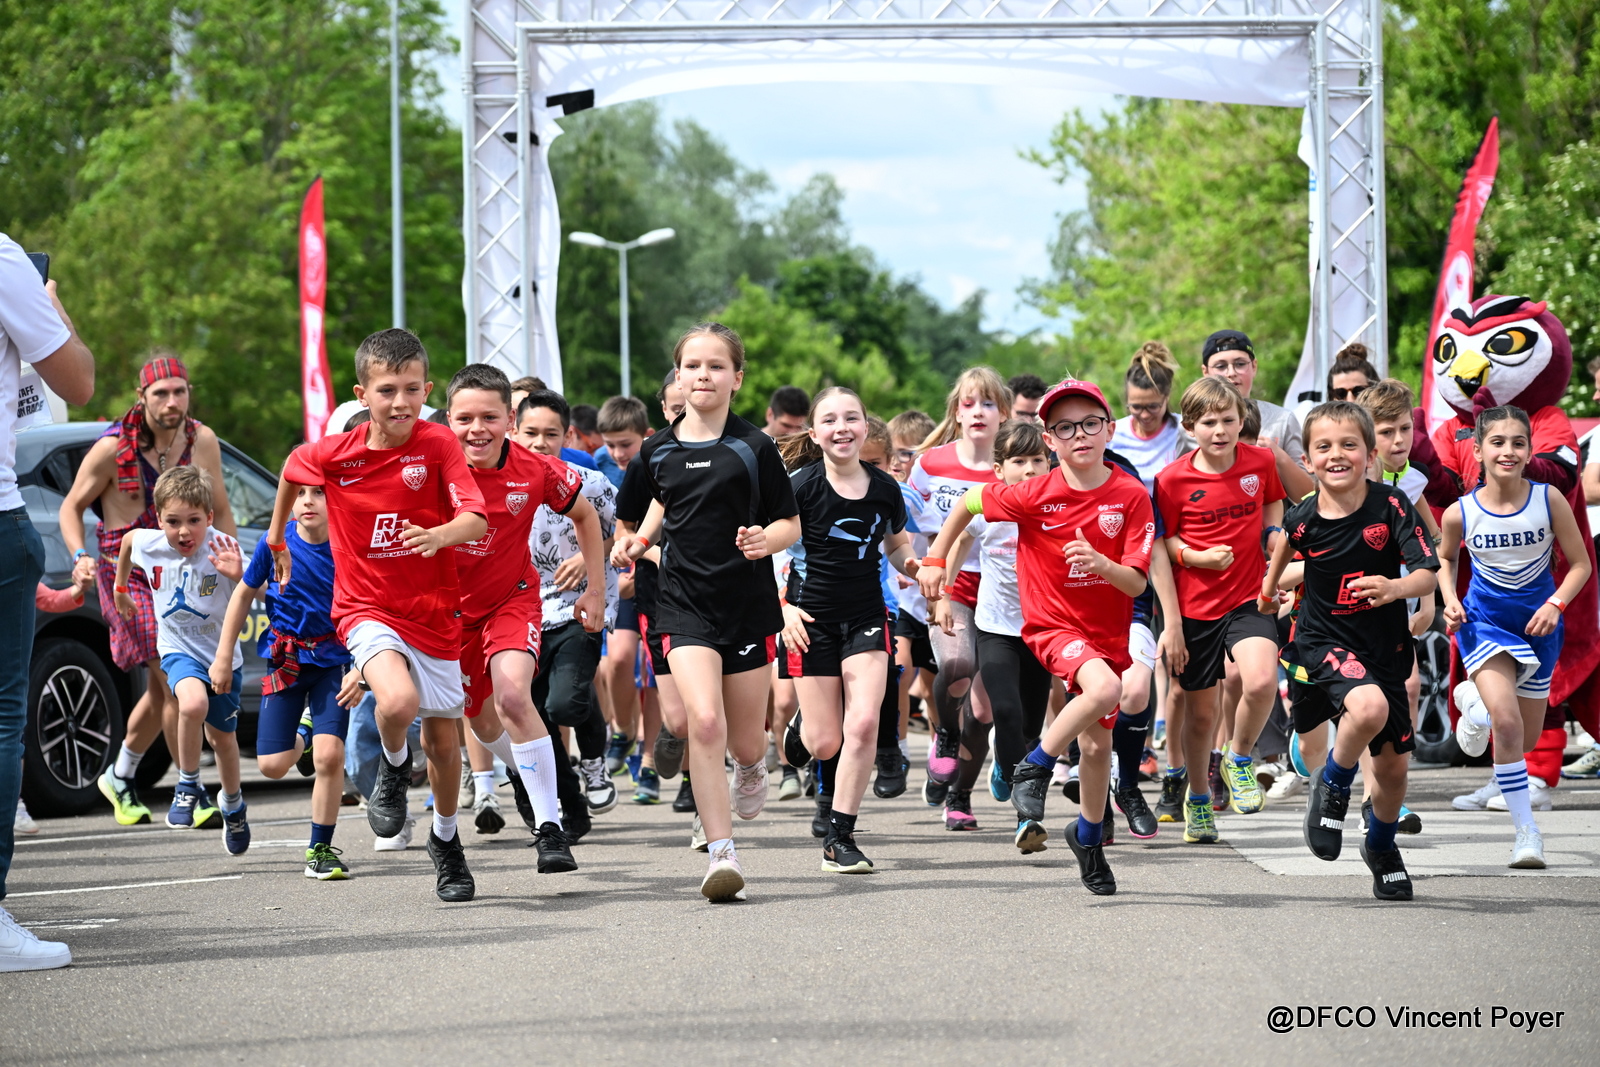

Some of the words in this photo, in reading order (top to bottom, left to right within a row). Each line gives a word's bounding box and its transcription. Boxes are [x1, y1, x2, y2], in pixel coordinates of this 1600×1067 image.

[685, 459, 712, 469] hummel
[1200, 501, 1257, 524] DFCO
[1141, 532, 1154, 555] leader
[1472, 527, 1545, 549] CHEERS
[1382, 871, 1408, 884] PUMA
